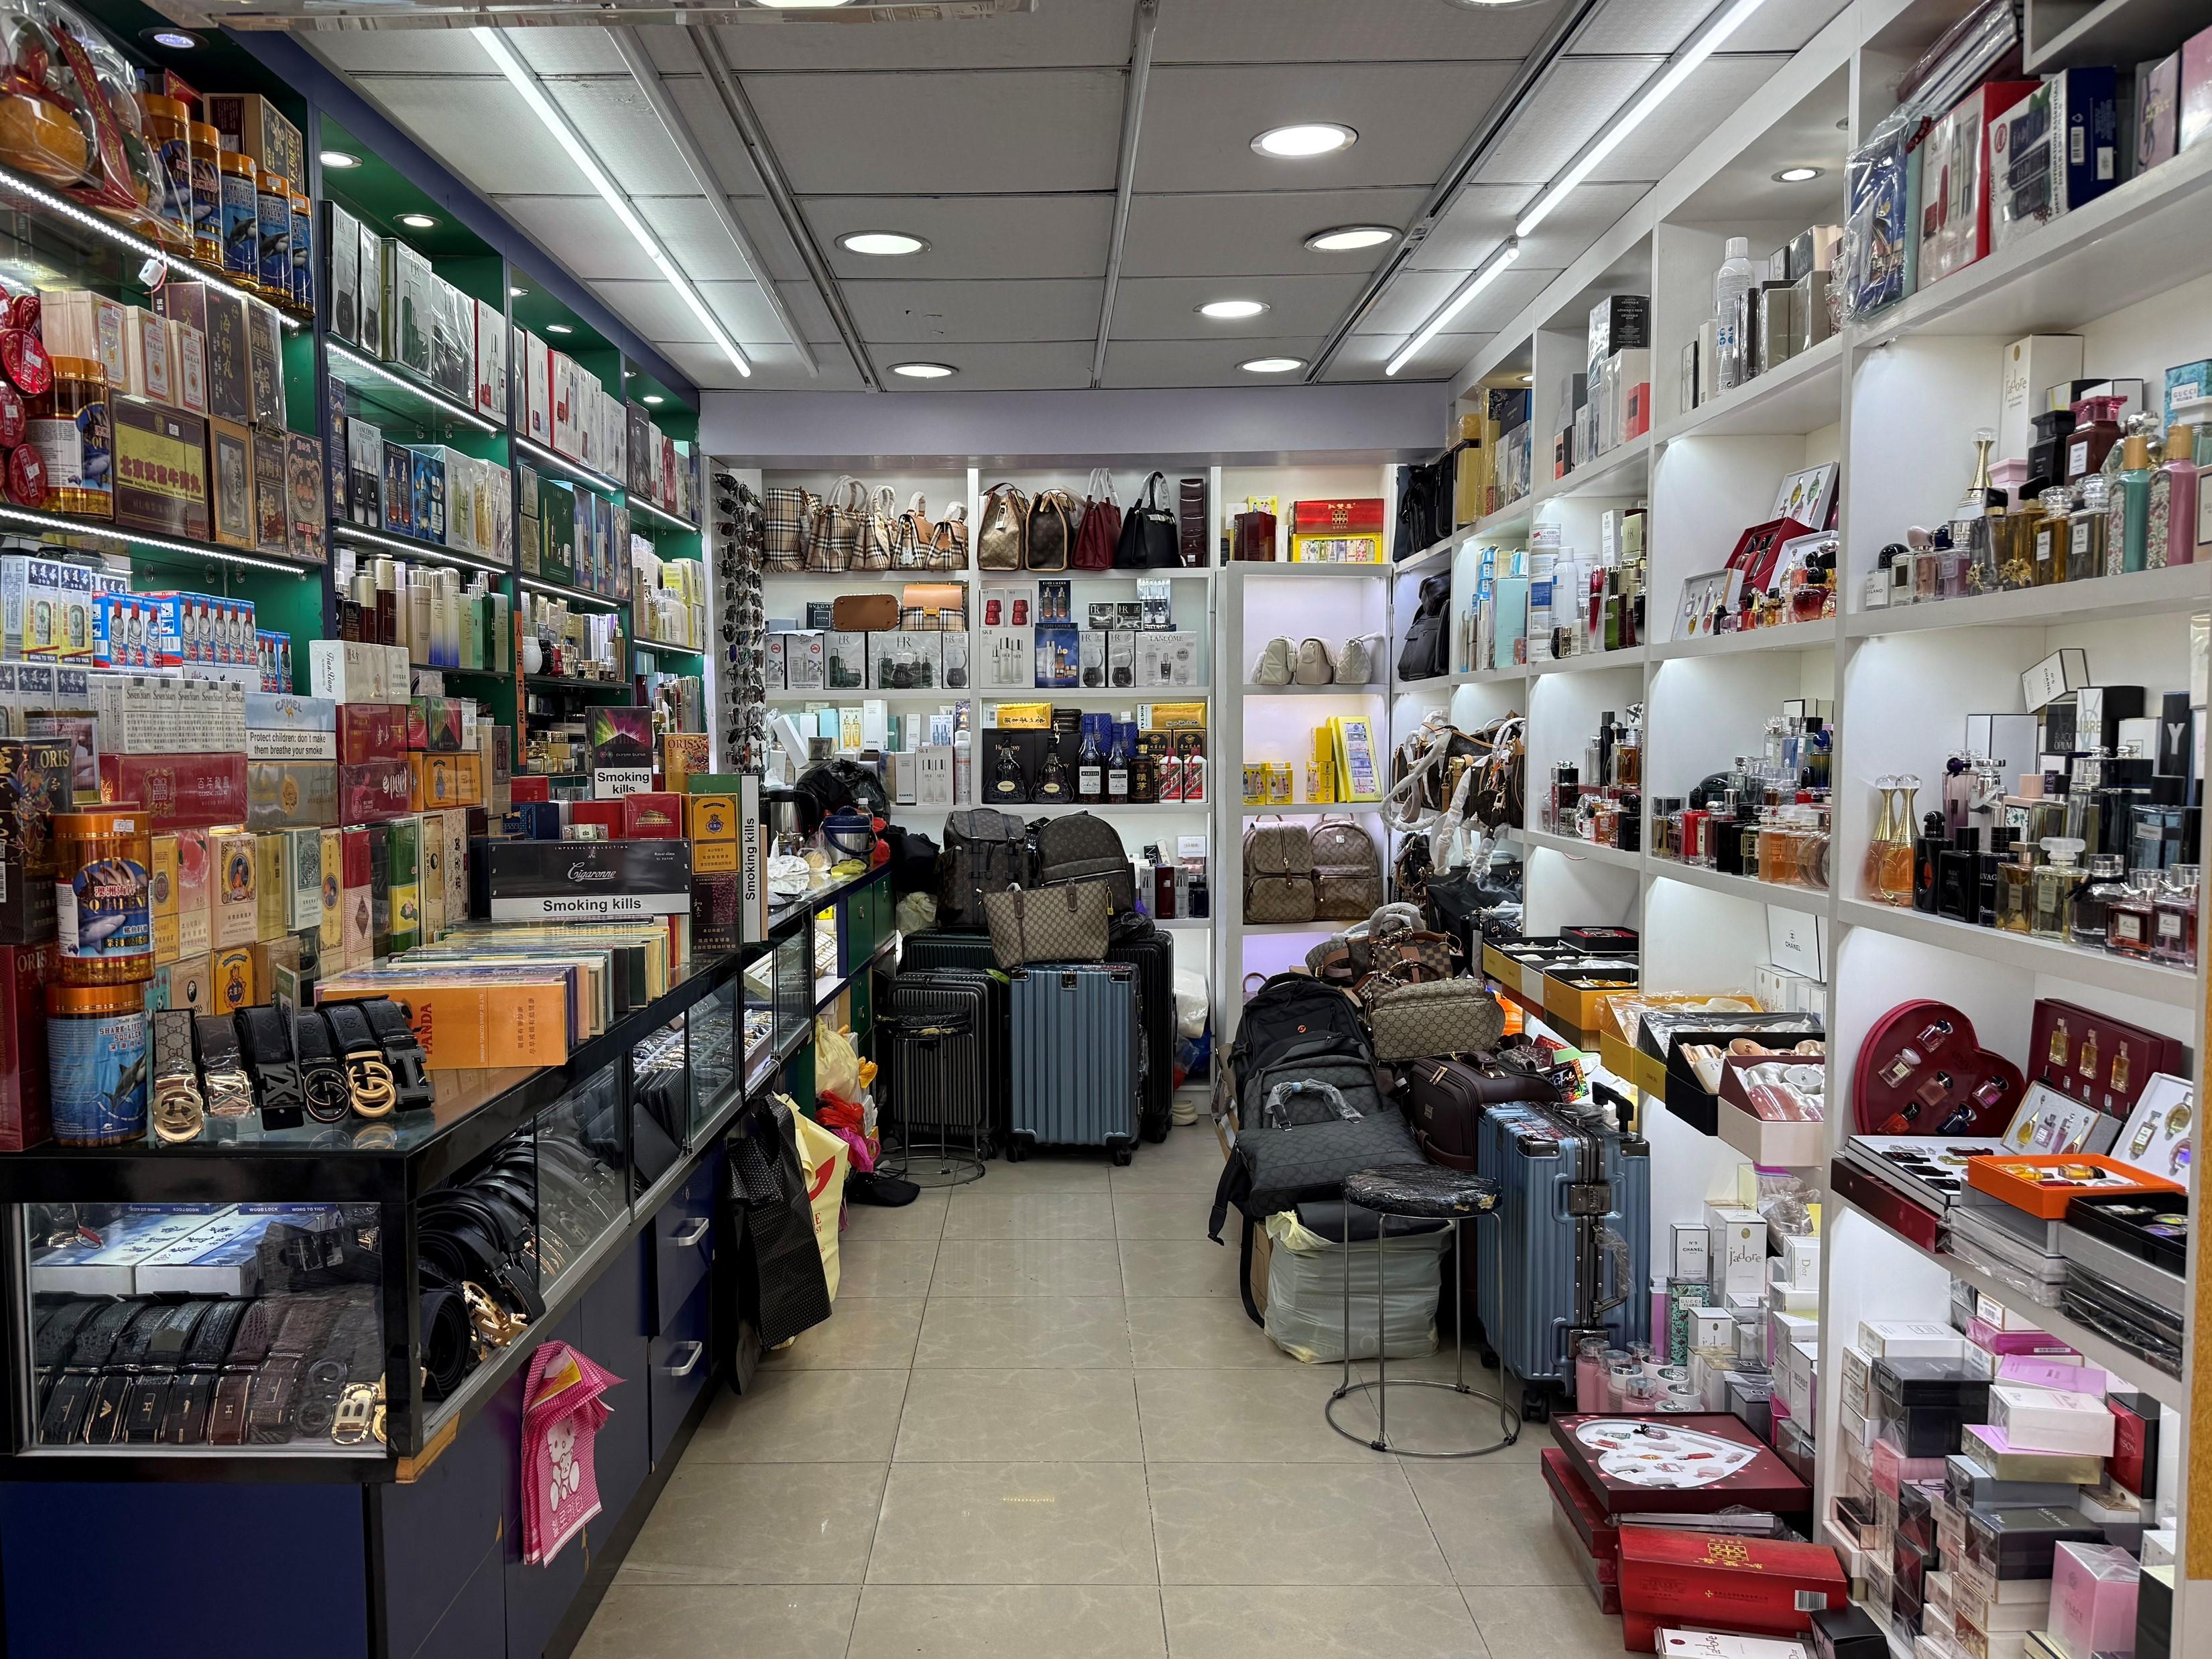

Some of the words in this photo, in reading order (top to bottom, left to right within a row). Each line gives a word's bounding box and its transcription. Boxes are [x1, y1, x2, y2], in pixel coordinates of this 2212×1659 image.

[2172, 388, 2197, 400] GUCCI
[838, 635, 851, 644] HR
[897, 636, 912, 648] HR
[275, 698, 302, 713] CAMEL
[2075, 720, 2101, 733] LIBRE
[250, 732, 271, 742] Protect
[272, 733, 296, 743] children:
[312, 734, 326, 743] make
[2054, 732, 2072, 741] BLACK
[2166, 723, 2186, 755] Y
[668, 739, 693, 749] ORIS
[2054, 741, 2073, 750] OPIUM
[254, 745, 269, 754] them
[270, 745, 292, 755] breathe
[292, 747, 305, 757] your
[306, 746, 322, 755] smoke
[40, 749, 70, 769] ORIS
[597, 772, 650, 784] Smoking
[613, 784, 636, 795] kills
[745, 817, 755, 843] kills
[567, 861, 617, 882] Cigaronne
[745, 843, 757, 901] Smoking
[543, 899, 607, 913] Smoking
[613, 898, 641, 910] kills
[1785, 941, 1801, 953] CHANEL
[17, 950, 48, 973] ORIS
[421, 1002, 432, 1055] PANDA
[1729, 1245, 1762, 1267] j'adore
[1801, 1258, 1810, 1278] Dior
